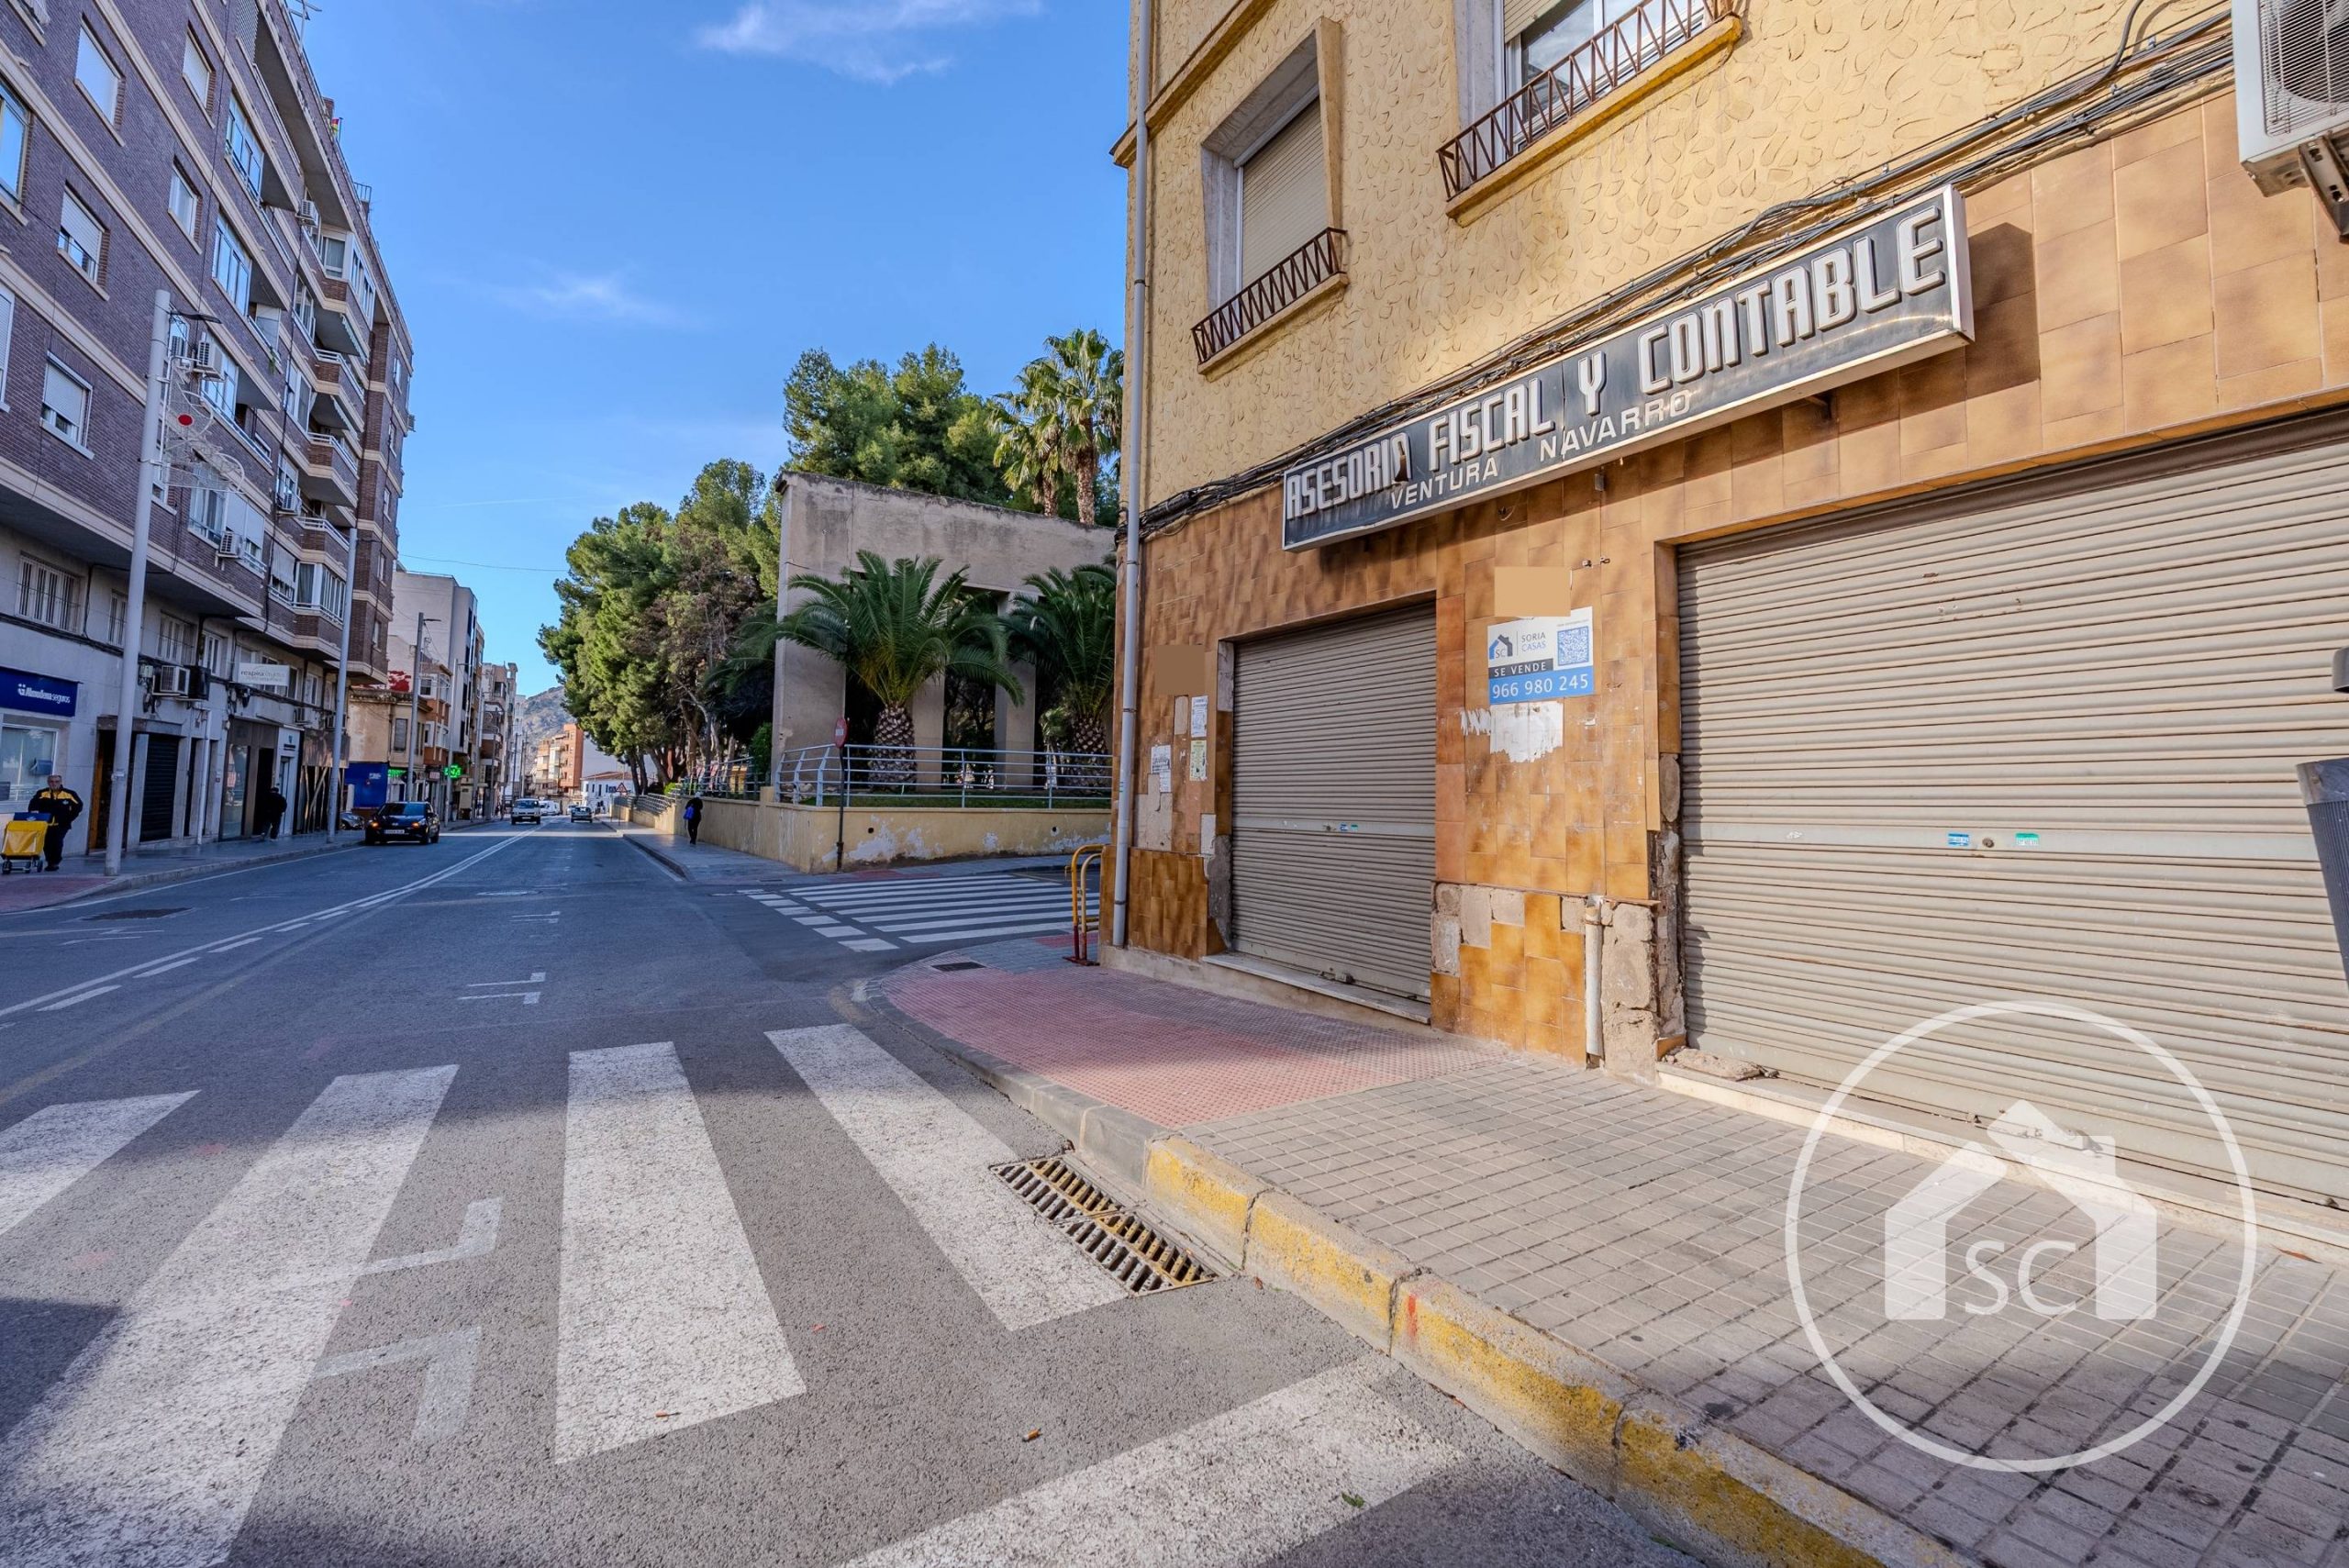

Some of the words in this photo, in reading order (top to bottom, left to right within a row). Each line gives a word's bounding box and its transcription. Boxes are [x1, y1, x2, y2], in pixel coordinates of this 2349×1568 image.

[1429, 377, 1555, 472] FISCAL
[1578, 350, 1606, 416] Y
[1638, 205, 1945, 395] CONTABLE
[1391, 457, 1498, 509] VENTURA
[1540, 389, 1690, 462] NAVARRO
[1521, 632, 1546, 642] SORIA
[1495, 648, 1507, 658] SC
[1521, 641, 1546, 652] CASAS
[1494, 668, 1506, 677] SE
[1510, 662, 1547, 675] VENDE
[1492, 682, 1519, 699] 966
[1524, 678, 1553, 695] 980
[1559, 673, 1588, 691] 245
